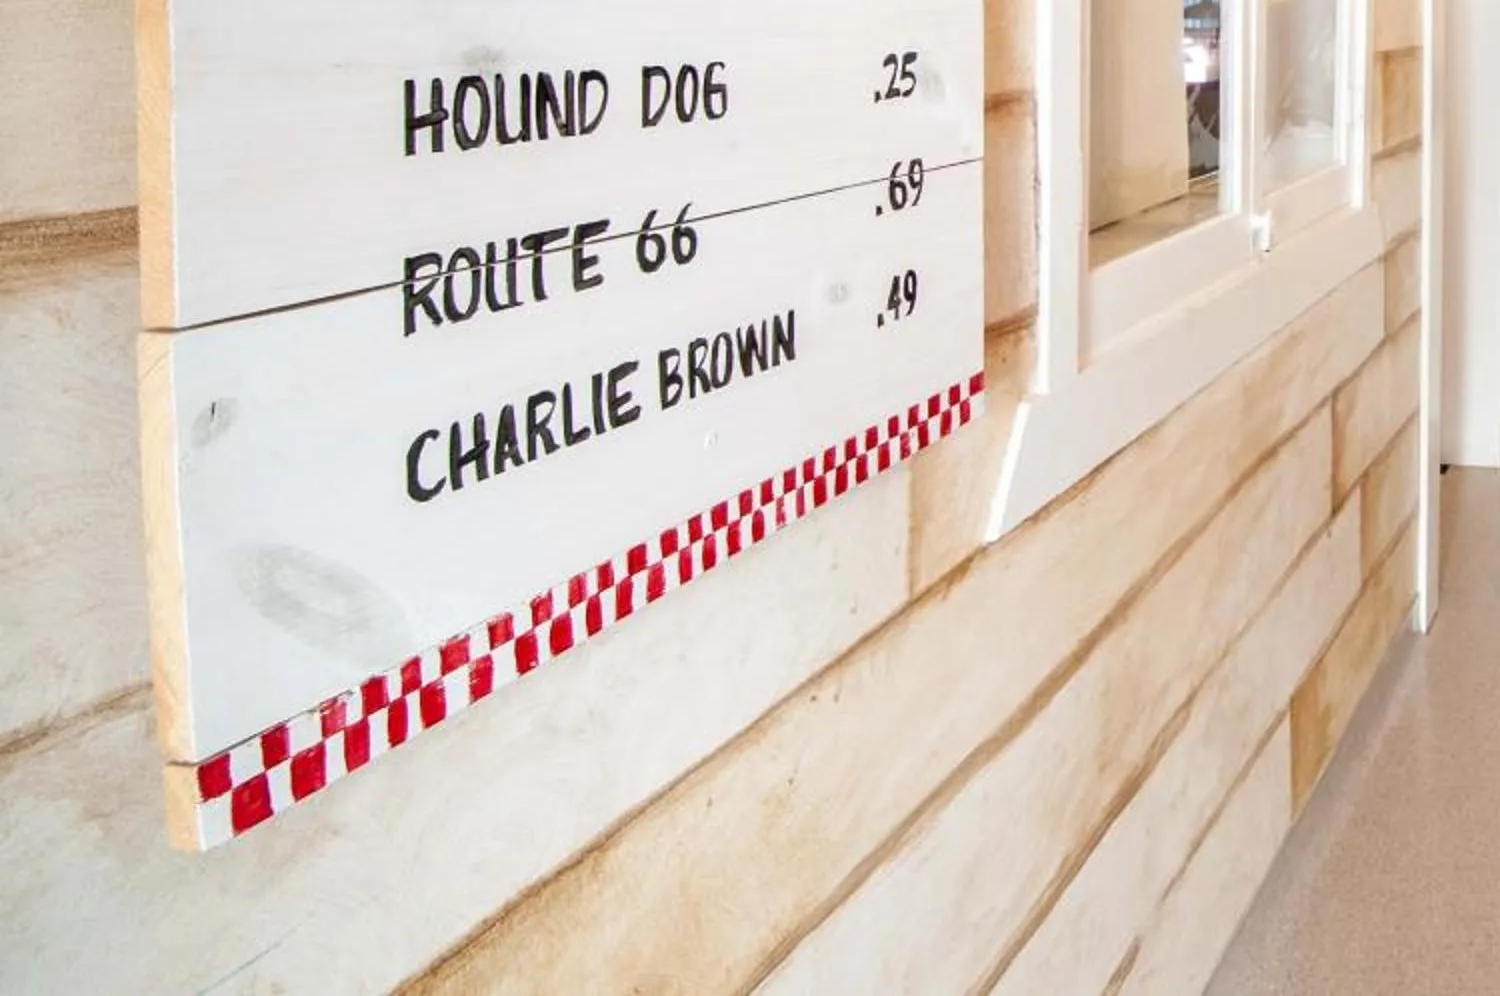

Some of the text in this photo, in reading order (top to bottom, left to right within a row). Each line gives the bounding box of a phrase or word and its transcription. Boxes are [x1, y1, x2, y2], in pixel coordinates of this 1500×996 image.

[404, 61, 728, 157] HOUND DOG
[873, 50, 918, 103] .25
[875, 157, 925, 217] .69
[403, 204, 699, 336] ROUTE 66
[877, 269, 918, 328] .49
[405, 310, 797, 503] CHARLIE BROWN
